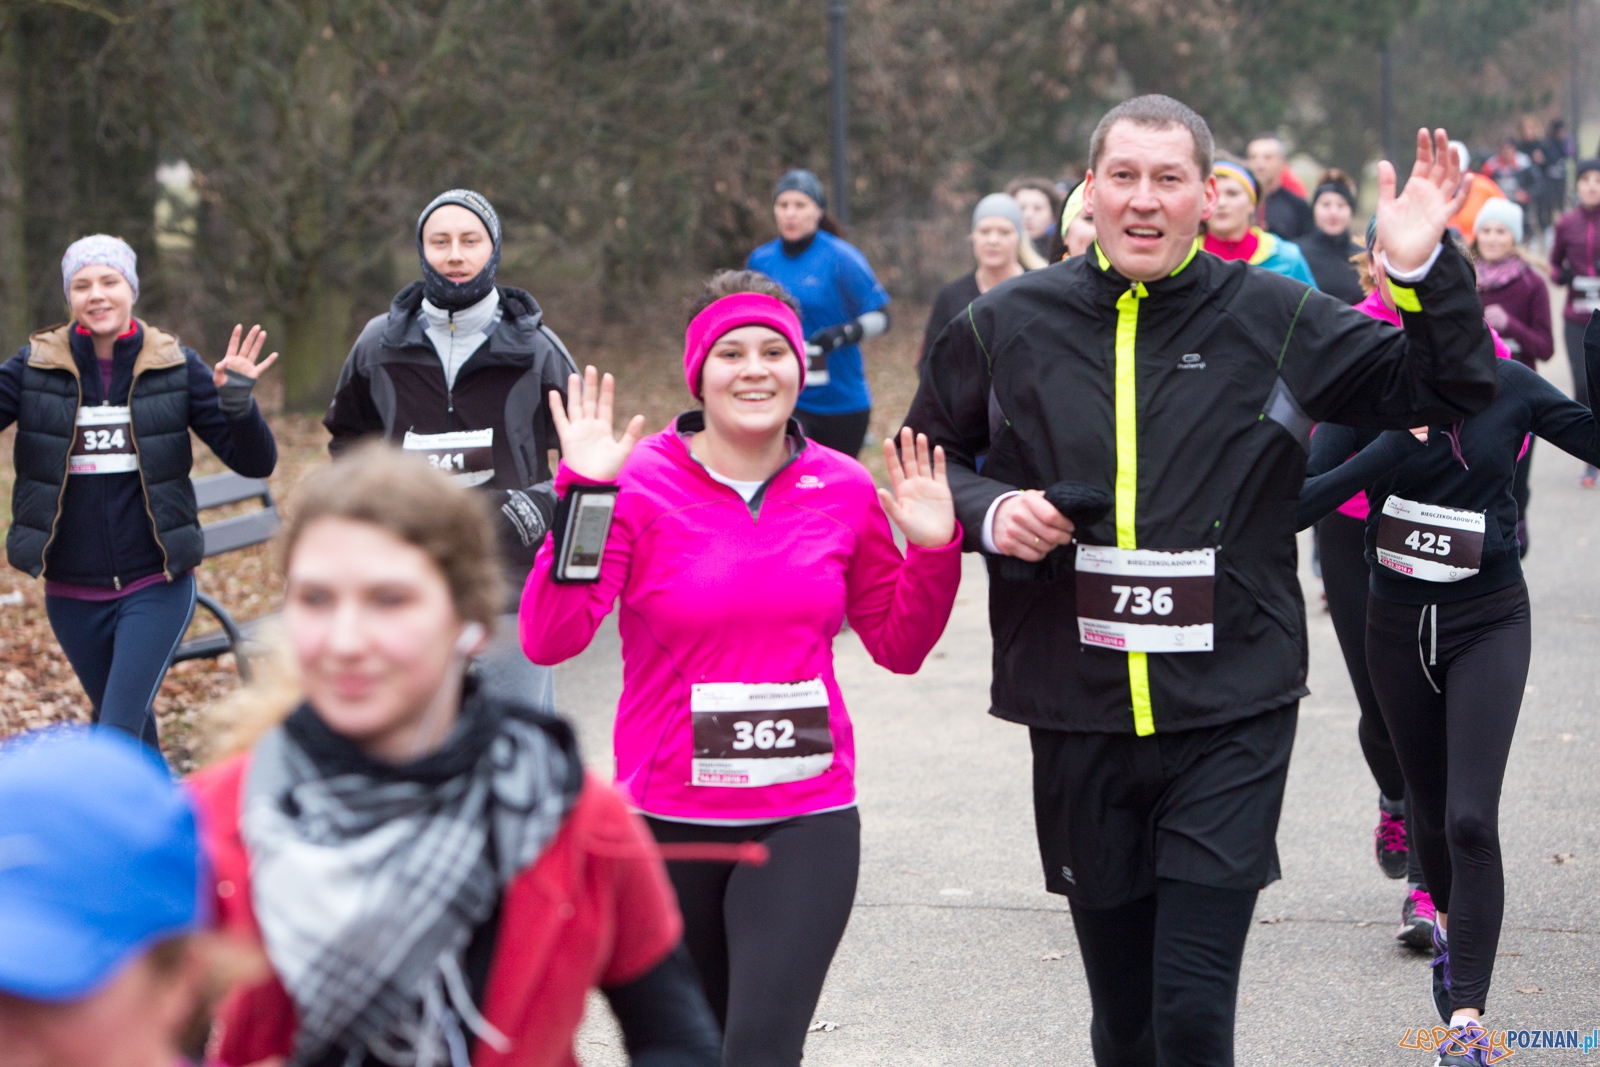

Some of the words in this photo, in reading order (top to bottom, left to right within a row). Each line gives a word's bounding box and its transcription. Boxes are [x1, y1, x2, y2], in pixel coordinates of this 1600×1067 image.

[83, 428, 126, 451] 324
[427, 452, 465, 472] 341
[1420, 511, 1481, 525] BIEGCZEKOLADOWY.PL
[1404, 529, 1451, 557] 425
[1111, 584, 1174, 616] 736
[732, 718, 796, 751] 362
